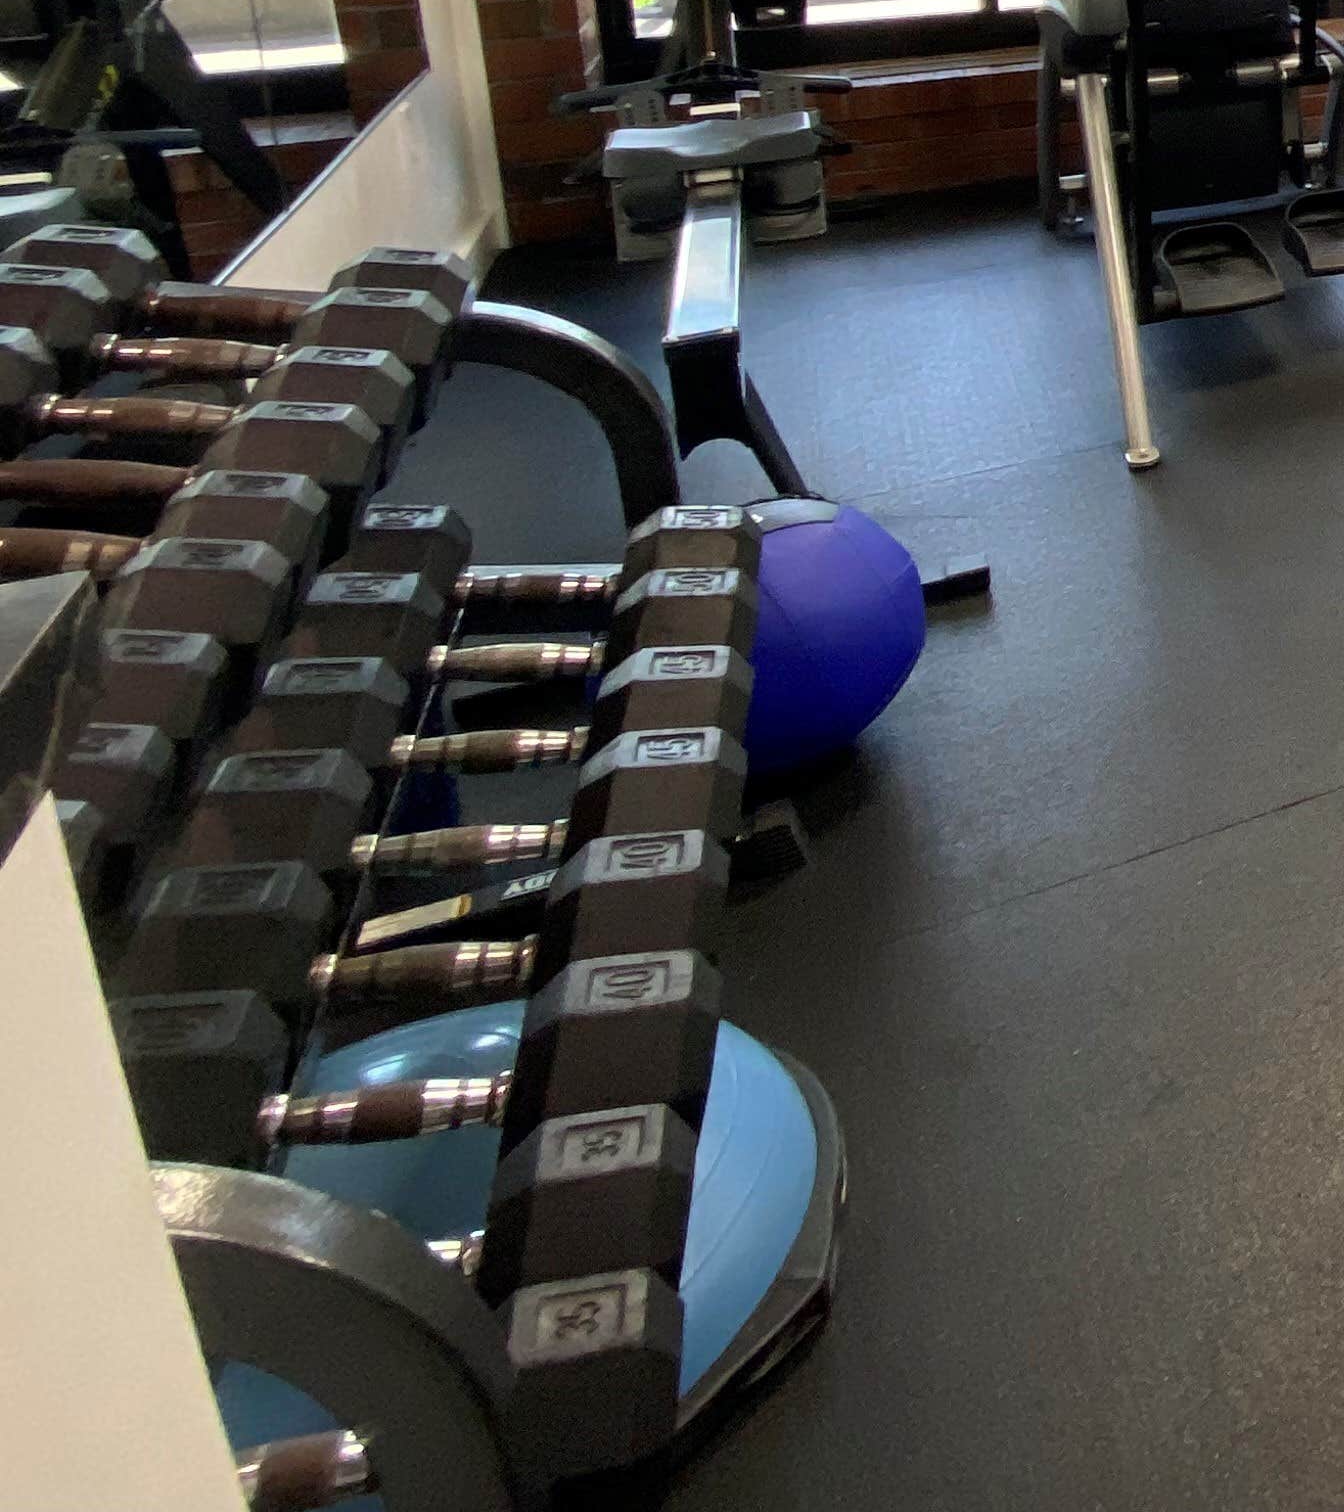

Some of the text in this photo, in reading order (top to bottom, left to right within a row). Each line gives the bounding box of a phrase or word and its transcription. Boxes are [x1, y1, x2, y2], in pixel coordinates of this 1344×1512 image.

[619, 842, 668, 870] 40
[602, 970, 655, 999] 40
[580, 1129, 624, 1163] 35
[554, 1299, 601, 1339] 35
